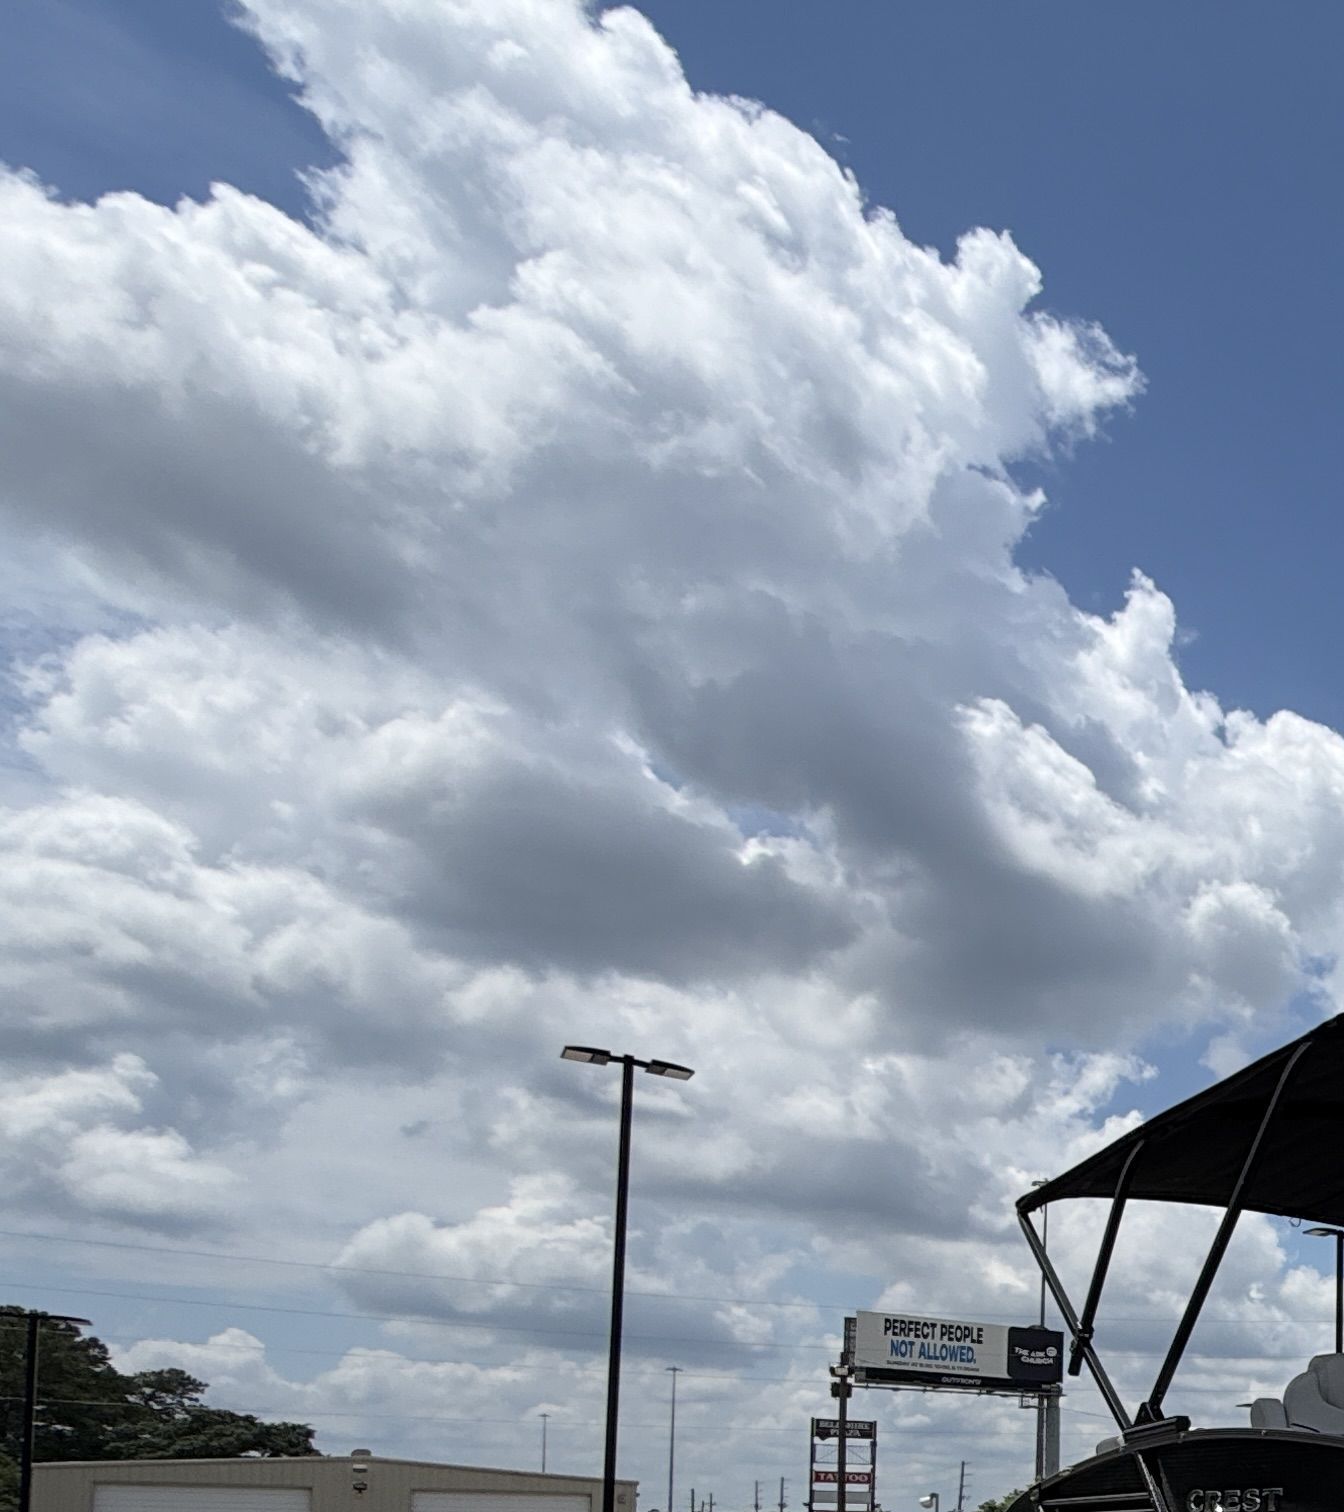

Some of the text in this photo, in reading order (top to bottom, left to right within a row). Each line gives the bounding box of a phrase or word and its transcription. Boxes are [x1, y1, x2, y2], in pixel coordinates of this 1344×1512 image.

[884, 1318, 984, 1344] PERFECT PEOPLE
[890, 1339, 916, 1358] NOT
[1014, 1346, 1030, 1356] THE
[1020, 1355, 1054, 1365] CHURCH
